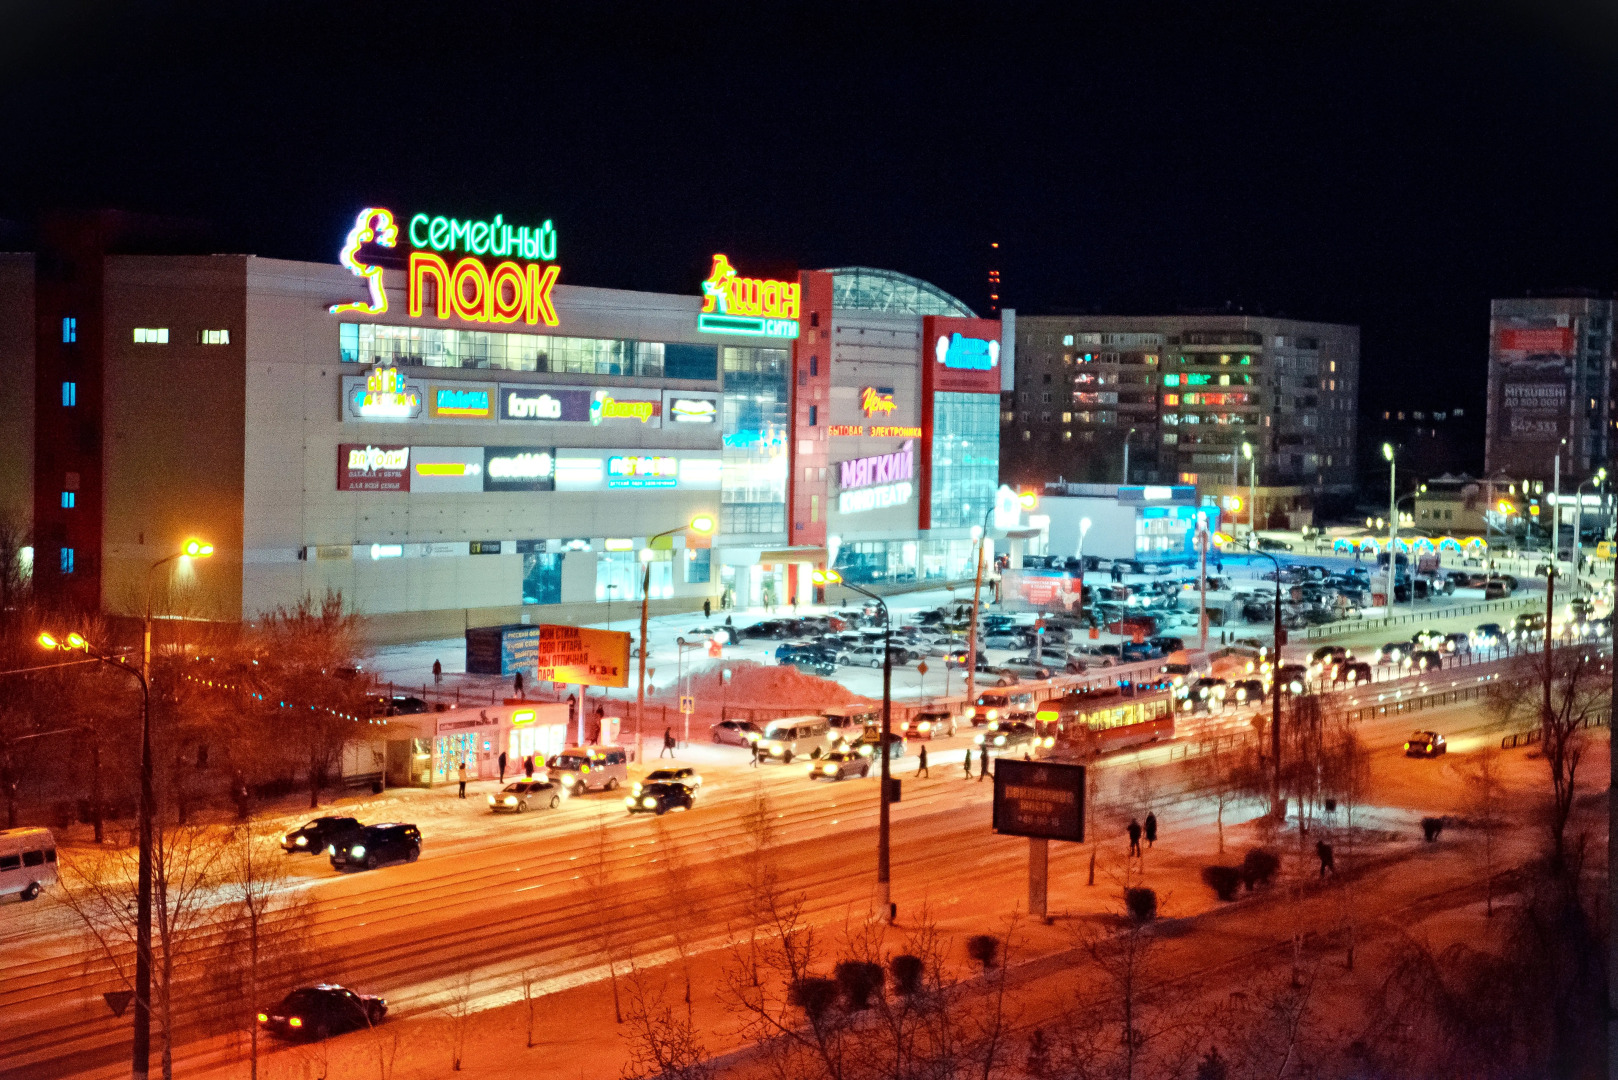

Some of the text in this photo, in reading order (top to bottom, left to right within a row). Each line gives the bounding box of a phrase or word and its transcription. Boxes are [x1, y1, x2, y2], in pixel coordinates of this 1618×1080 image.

[828, 426, 922, 438] БЫТОВАЯ ЭЛЕКТРОНИКА
[841, 440, 913, 488] МЯГКИЙ
[839, 482, 913, 514] КИНОТЕАТР
[558, 640, 582, 653] ГИТАРА
[552, 653, 588, 667] ОТЛИЧНАЯ
[537, 668, 555, 681] ПАРА
